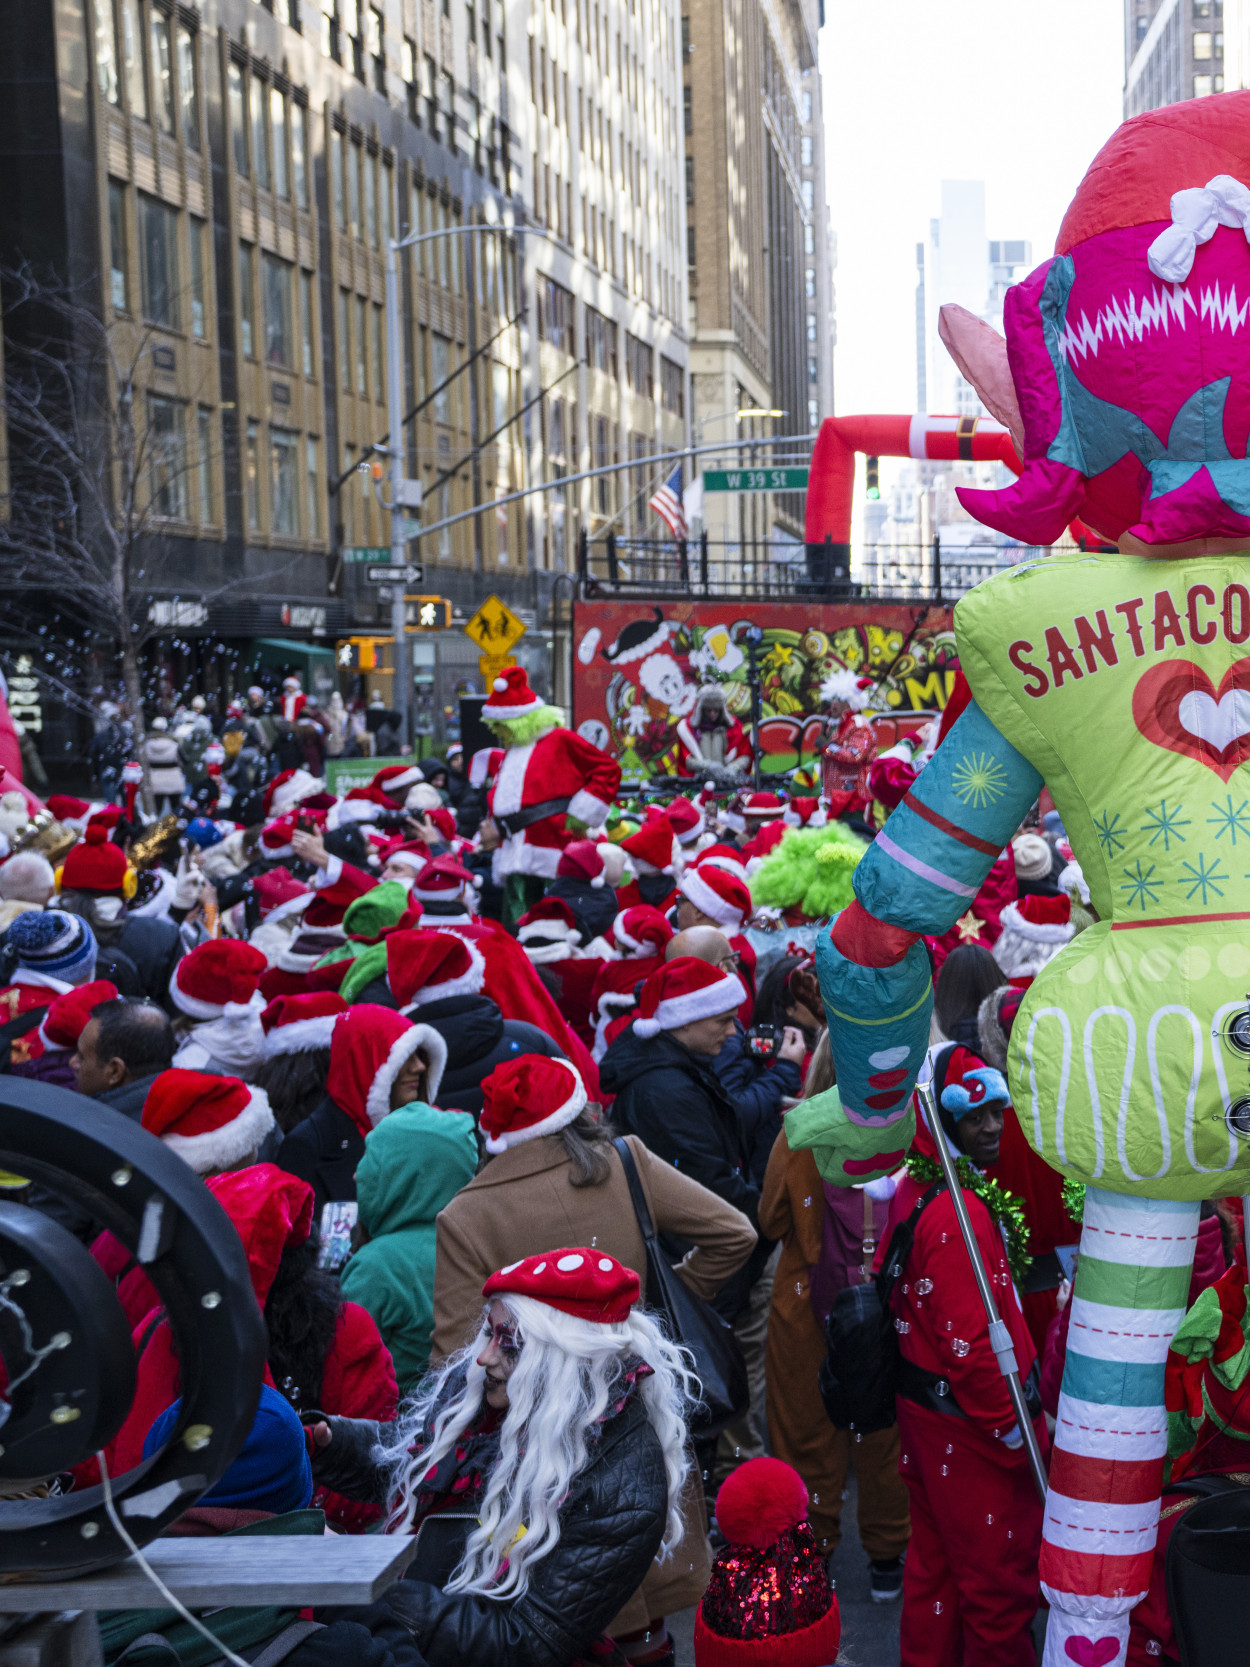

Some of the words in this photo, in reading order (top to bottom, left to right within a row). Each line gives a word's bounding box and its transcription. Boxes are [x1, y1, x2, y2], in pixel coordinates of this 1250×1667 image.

[726, 472, 742, 488] W
[747, 471, 766, 488] 39
[771, 470, 787, 487] St
